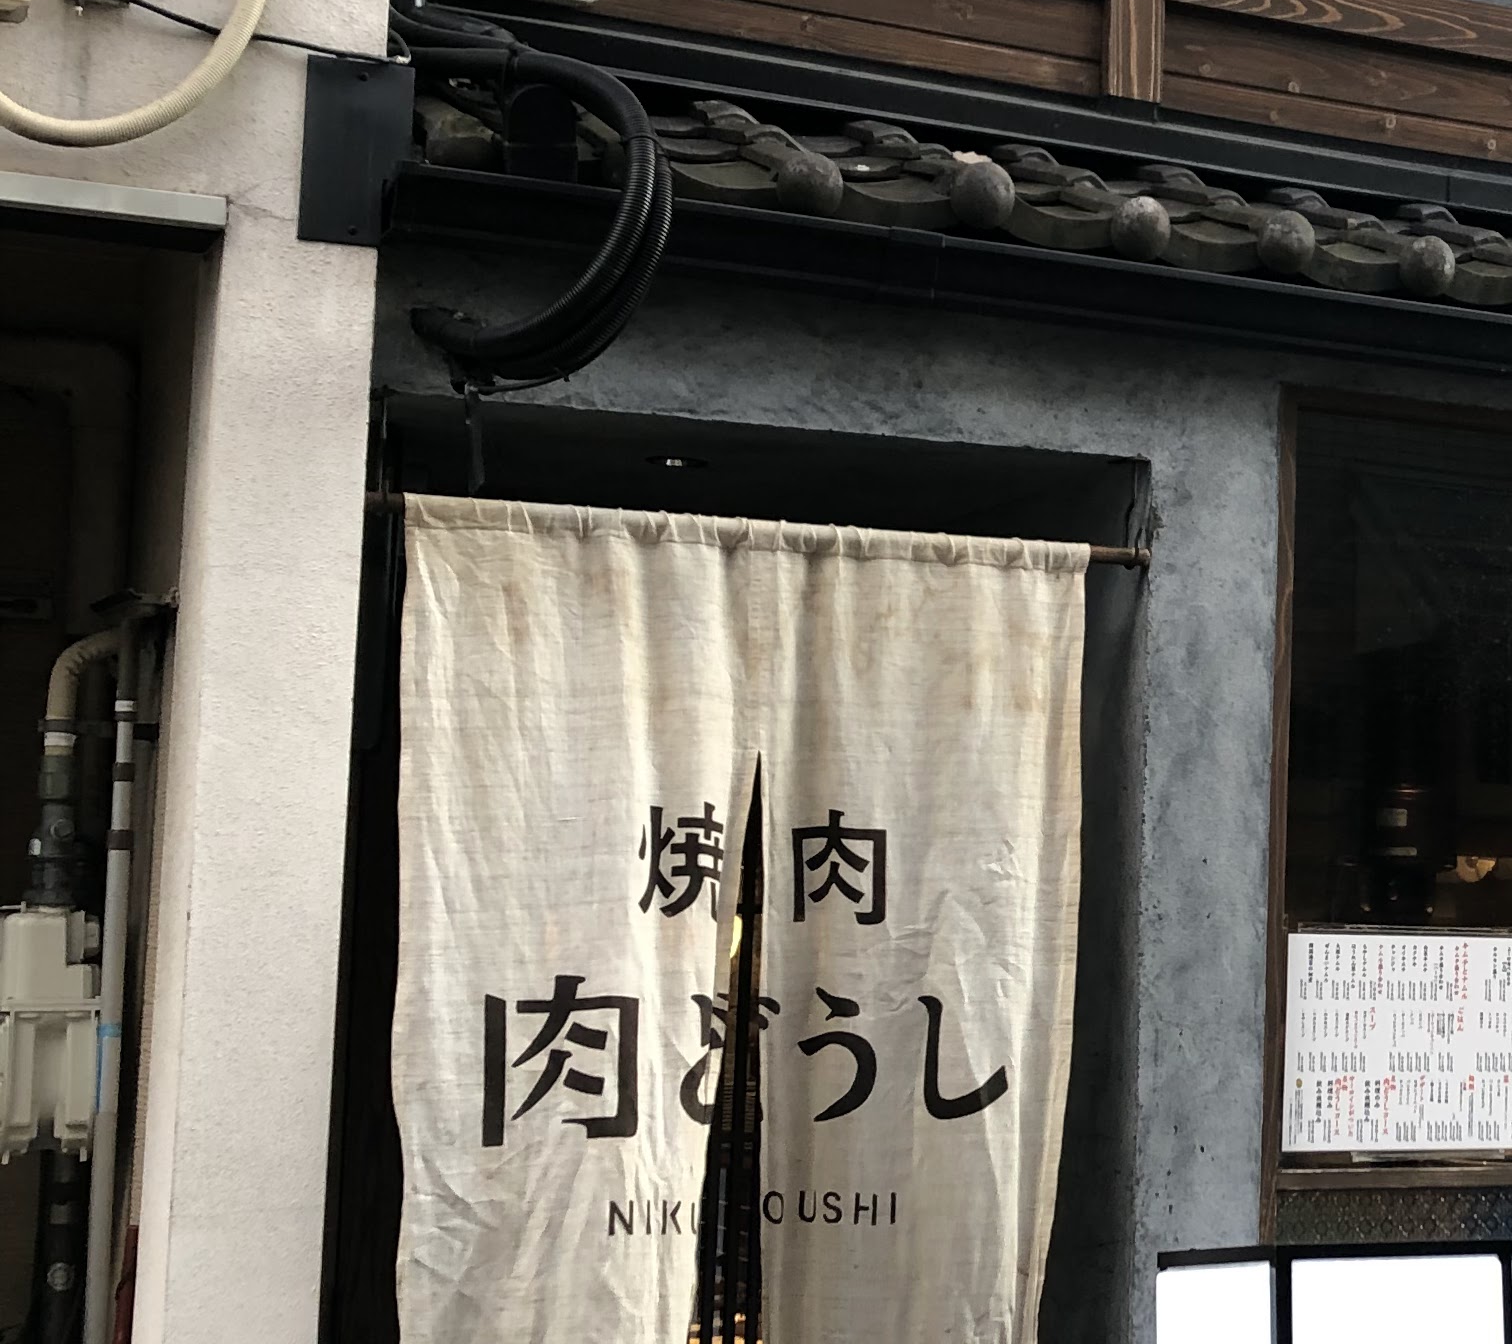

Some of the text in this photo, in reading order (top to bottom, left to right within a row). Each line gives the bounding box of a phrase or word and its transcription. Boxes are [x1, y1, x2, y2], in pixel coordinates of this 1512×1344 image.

[637, 800, 888, 926] 焼肉
[482, 974, 1009, 1148] 肉どうし
[608, 1190, 898, 1236] NIKOUSHI
